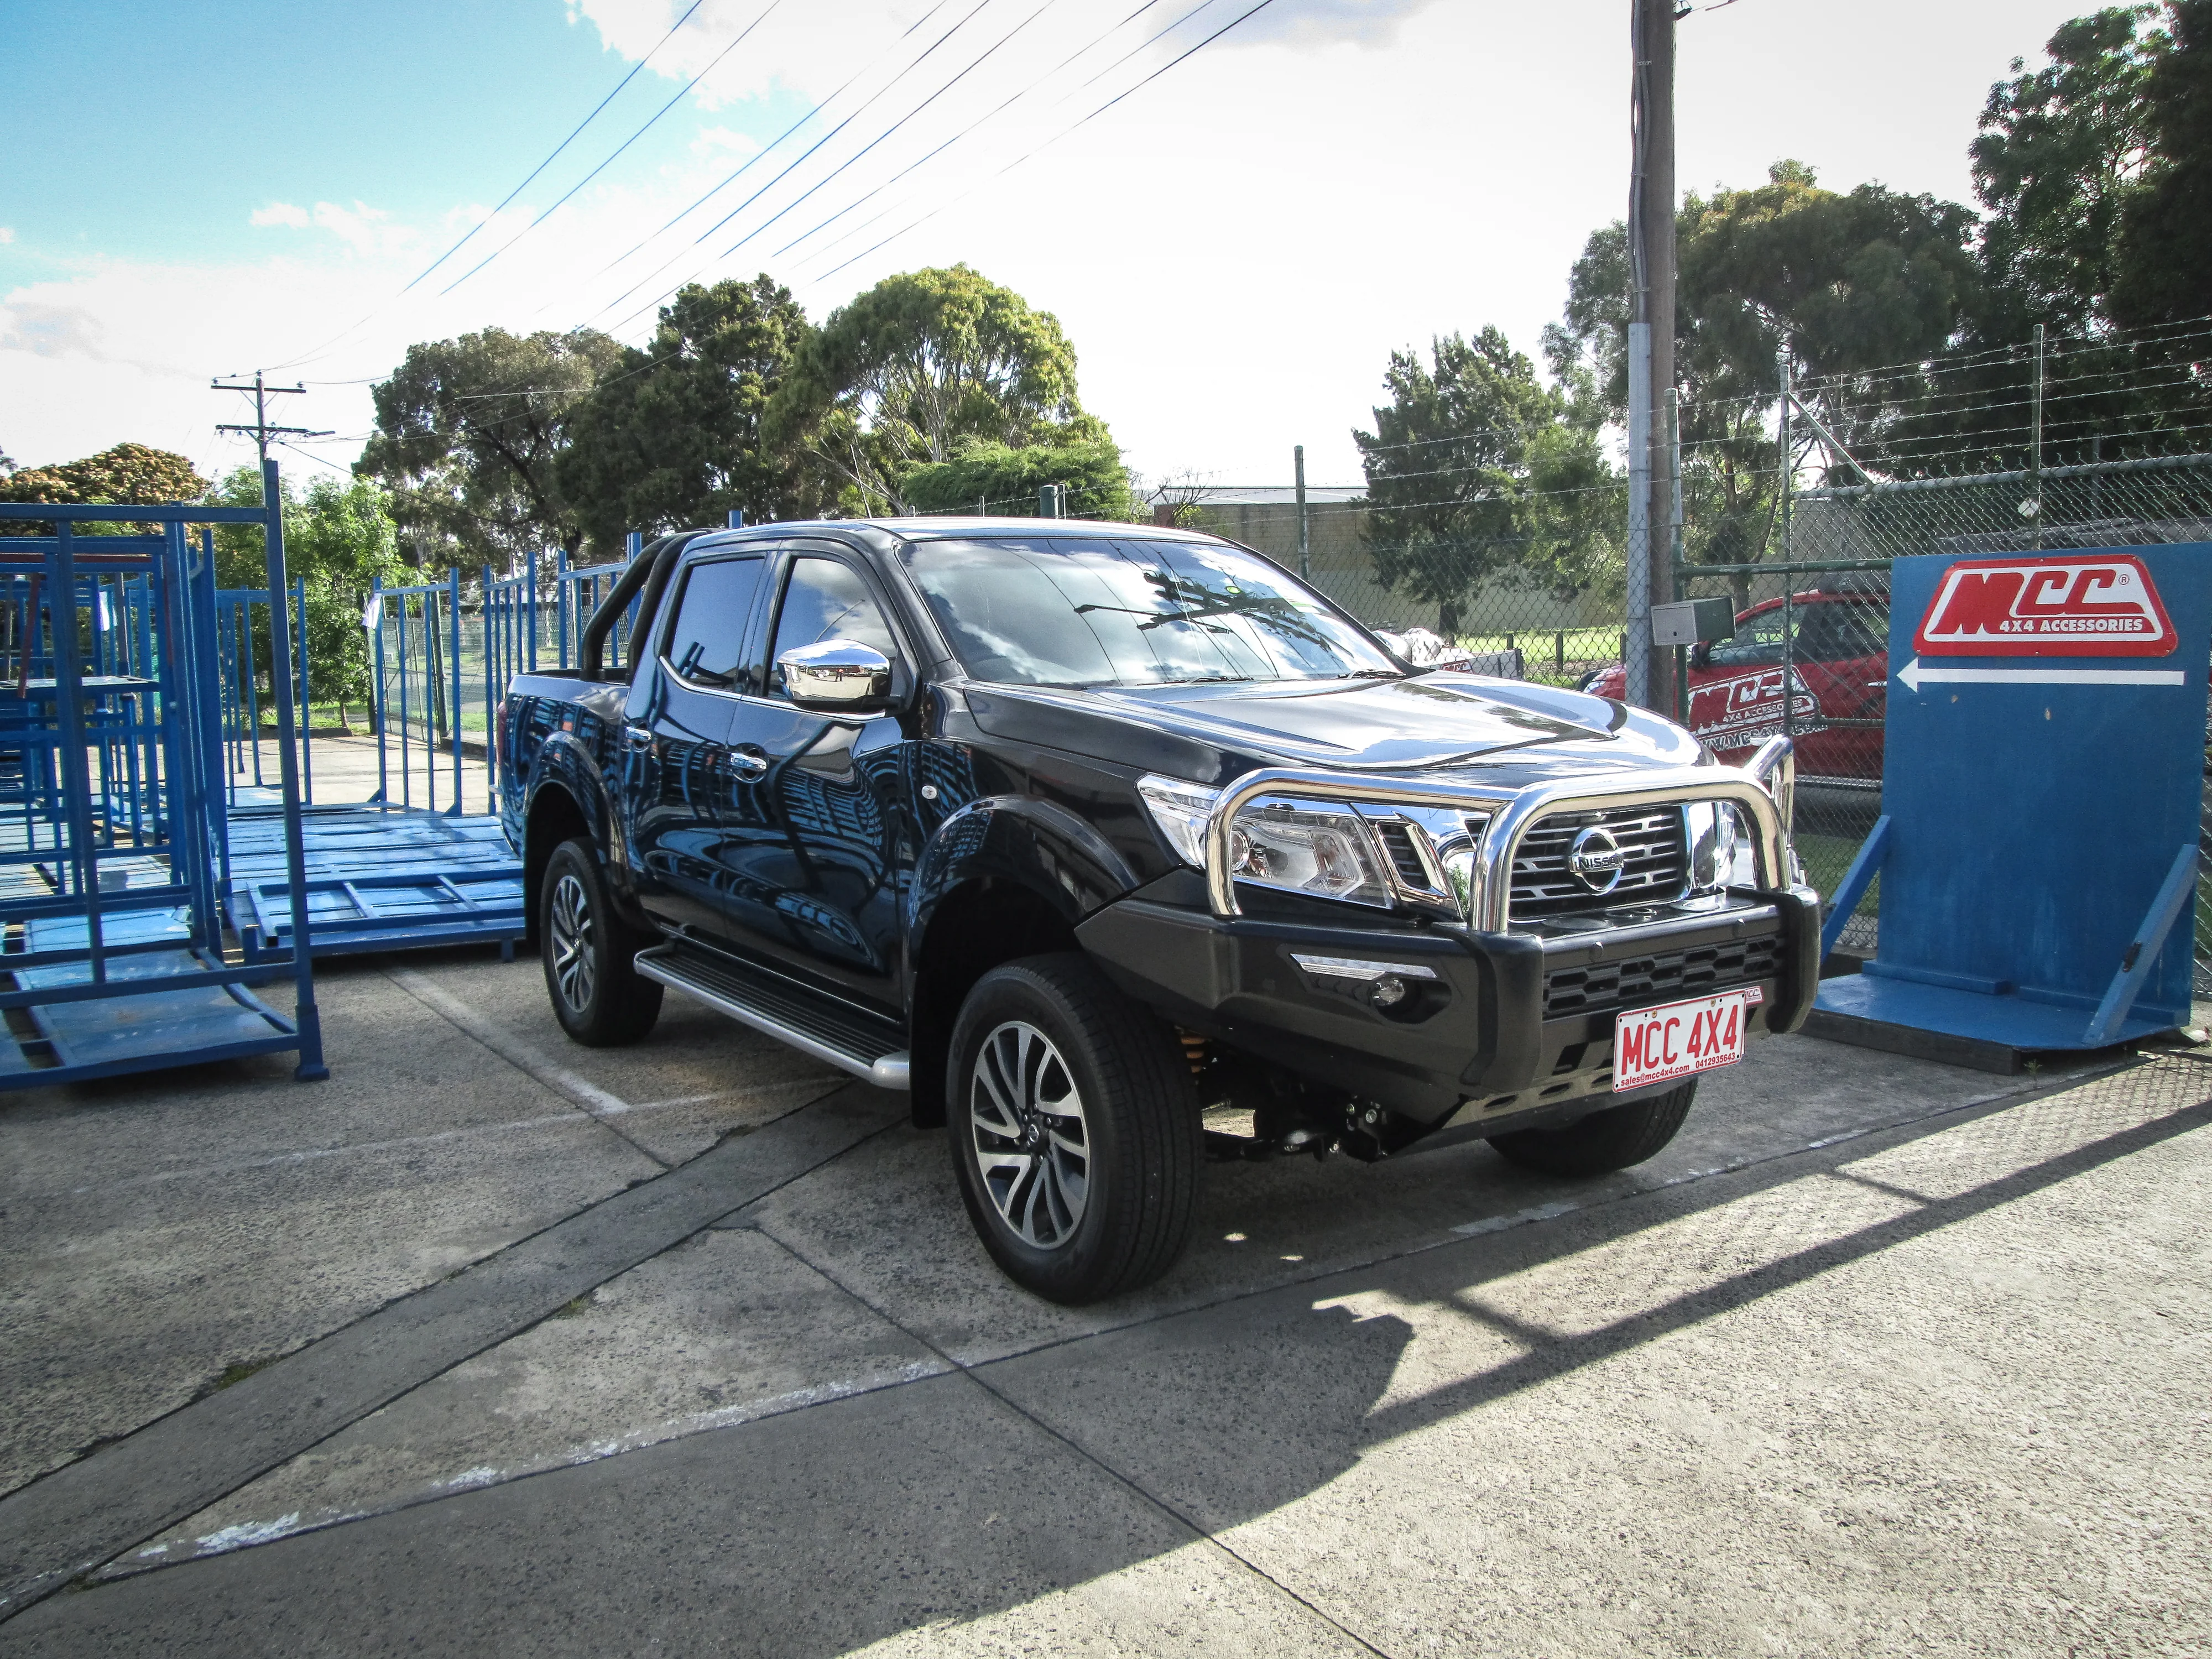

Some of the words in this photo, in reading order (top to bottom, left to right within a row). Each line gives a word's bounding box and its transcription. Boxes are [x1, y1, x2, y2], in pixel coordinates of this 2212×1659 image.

[1929, 568, 2146, 635] MCC
[1999, 620, 2035, 633] 4X4
[2039, 618, 2143, 633] ACCESSORIES
[1744, 698, 1803, 719] ACCESSOES
[1578, 855, 1624, 869] NISSAN
[1621, 1017, 1681, 1076] MCC
[1686, 1004, 1739, 1058] 4X4
[1620, 1063, 1690, 1087] sales@mcc4x4.com
[1695, 1052, 1736, 1069] 0412935643
